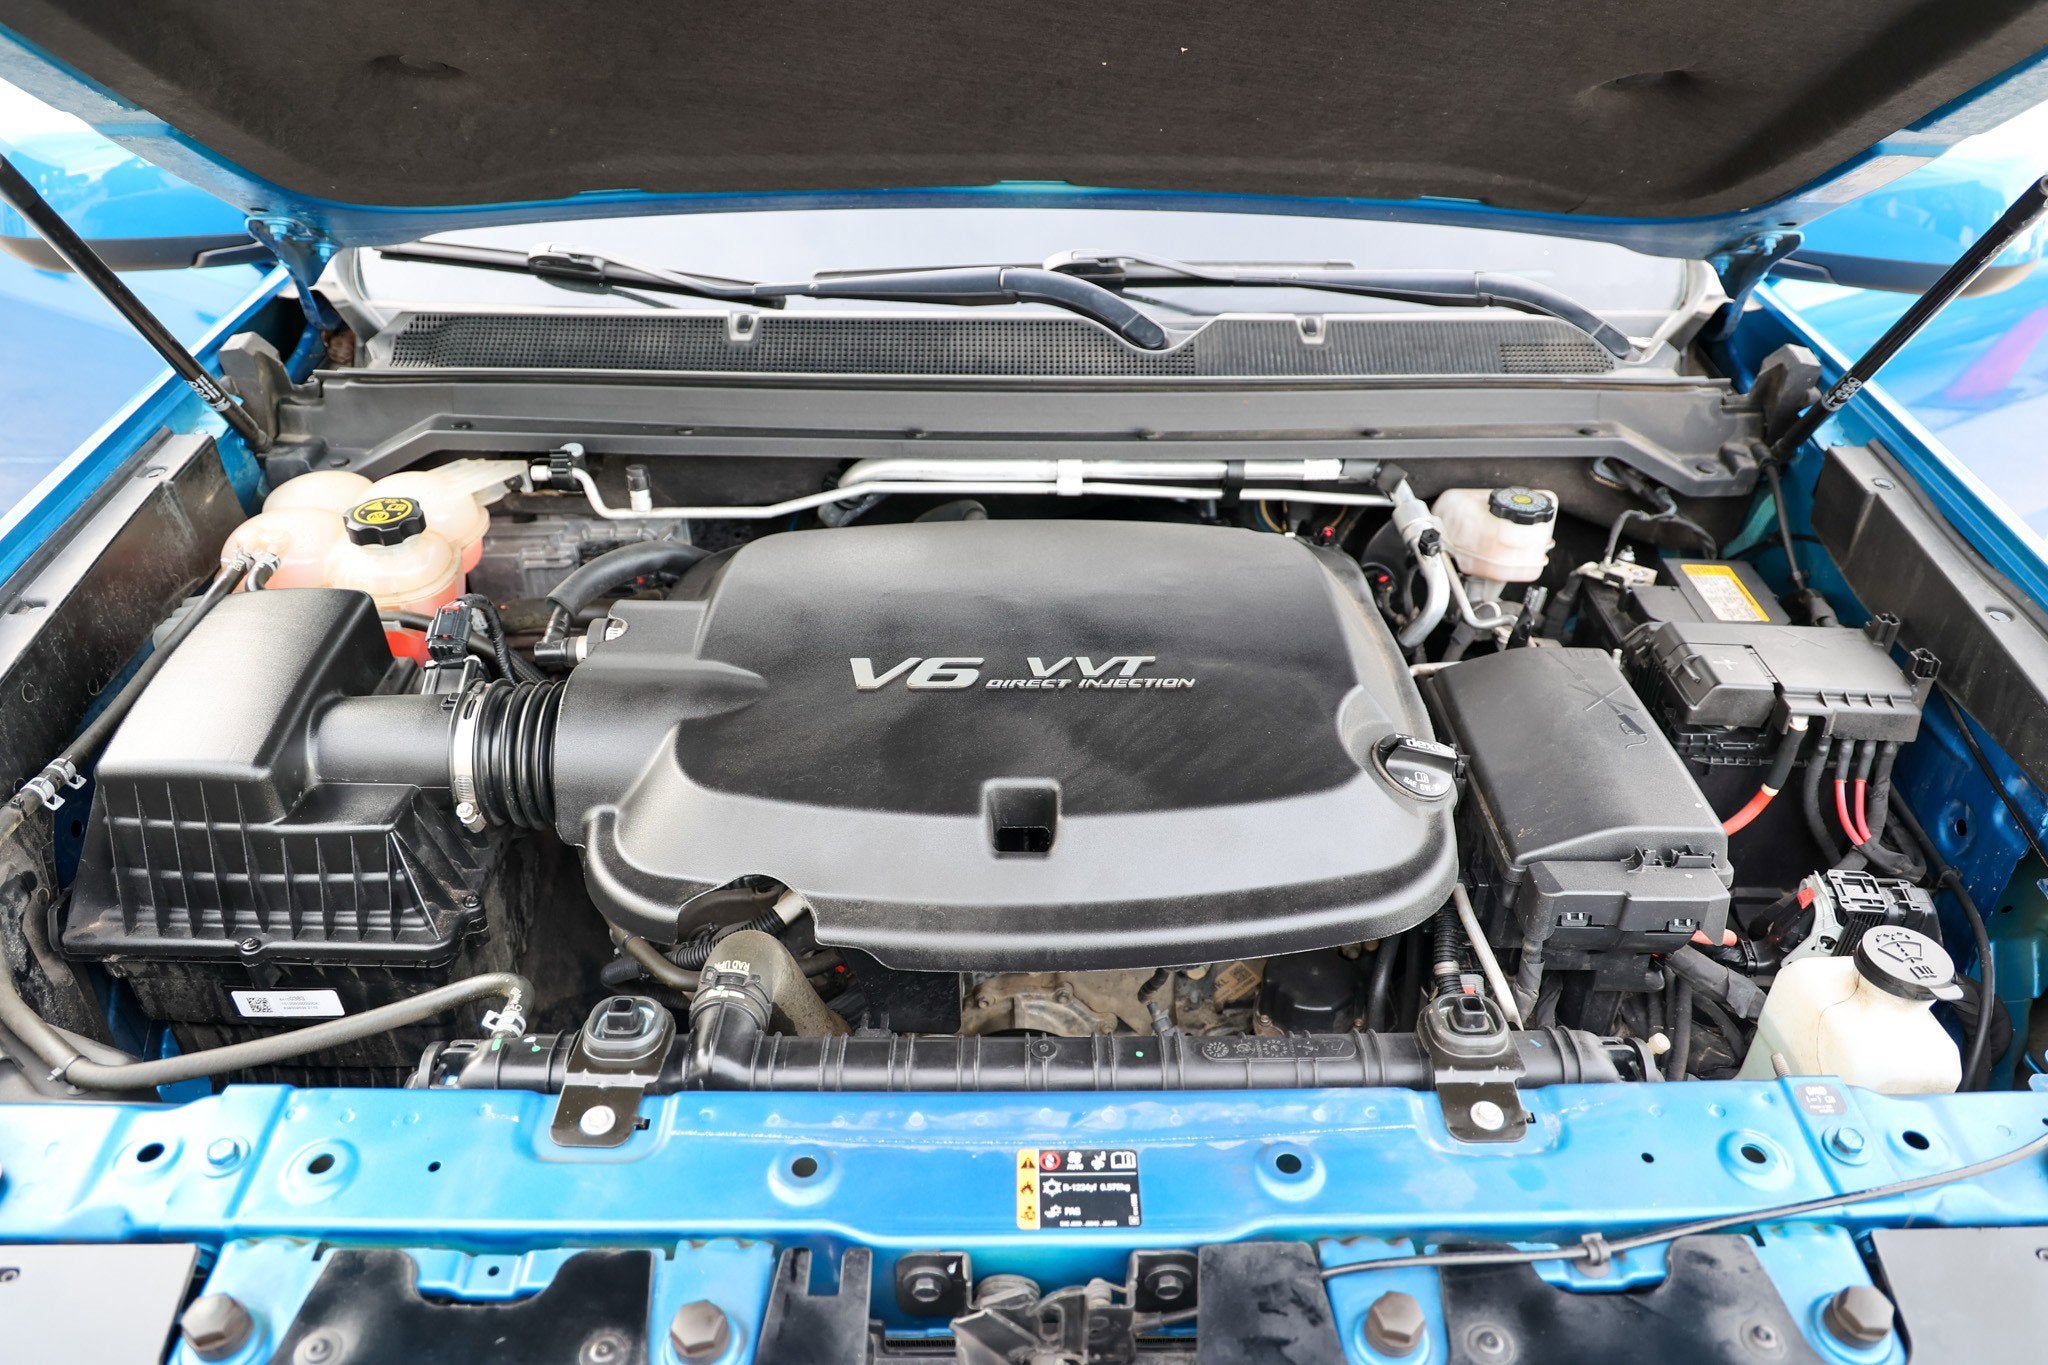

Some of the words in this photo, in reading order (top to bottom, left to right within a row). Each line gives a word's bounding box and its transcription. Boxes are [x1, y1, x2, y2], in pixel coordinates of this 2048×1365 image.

[850, 657, 984, 690] V6
[1027, 655, 1156, 678] VVT
[985, 678, 1072, 690] DIRECT
[1077, 677, 1196, 690] INJECTION
[731, 960, 751, 972] RAD
